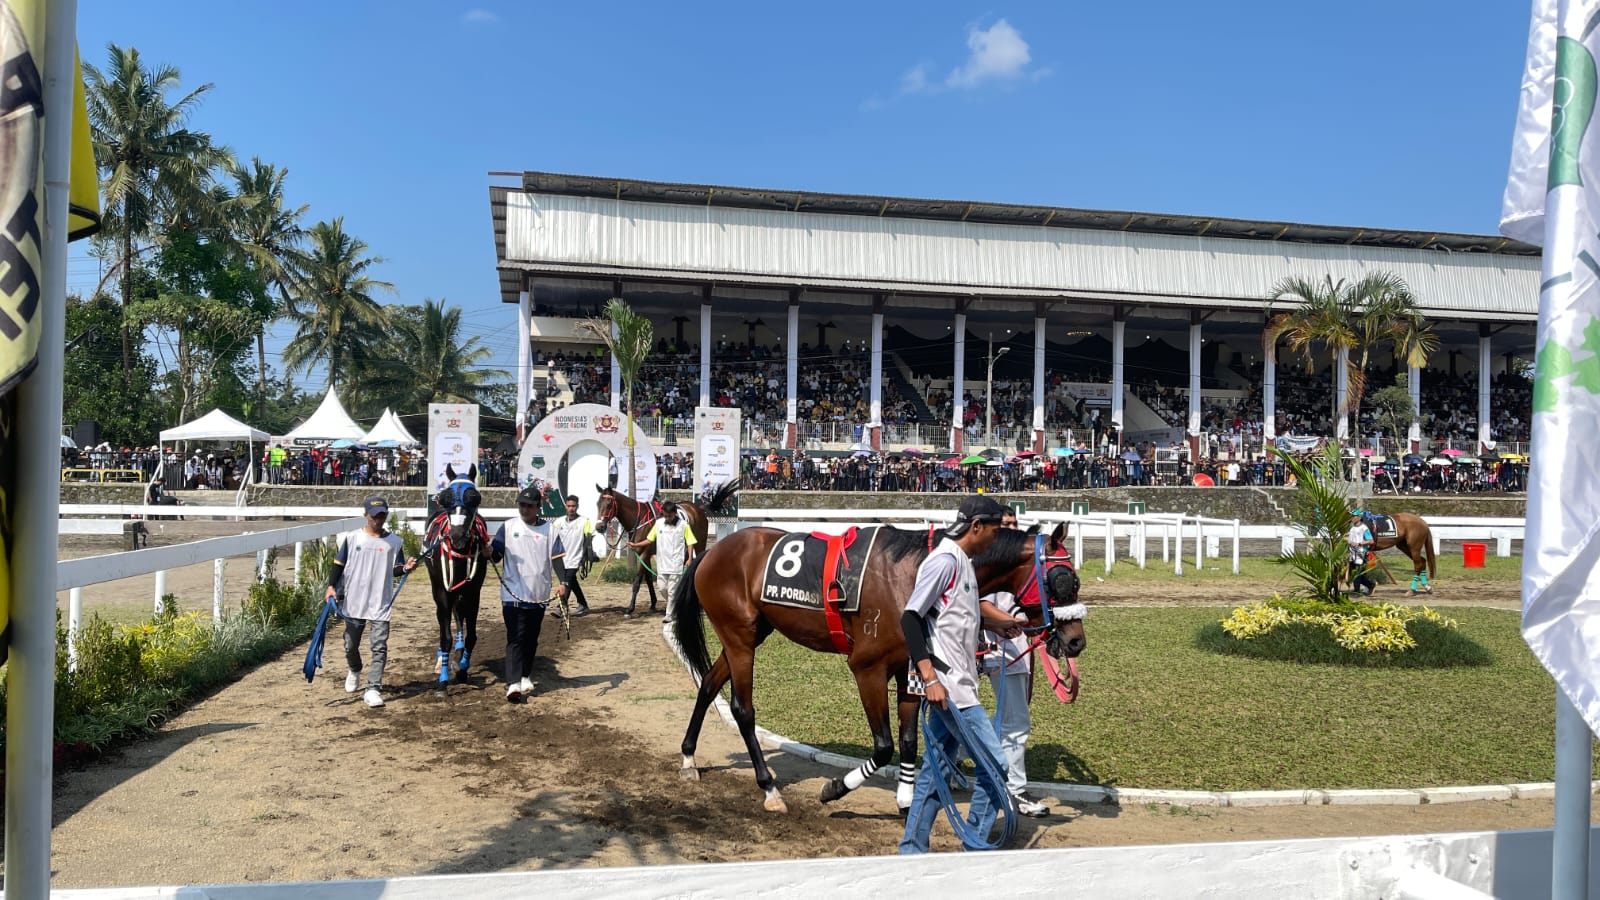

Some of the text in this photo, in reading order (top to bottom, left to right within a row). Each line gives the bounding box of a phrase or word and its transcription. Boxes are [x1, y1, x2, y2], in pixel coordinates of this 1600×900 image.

[1385, 519, 1396, 531] 1
[775, 540, 805, 578] 8
[766, 584, 820, 605] PR. PORDASI
